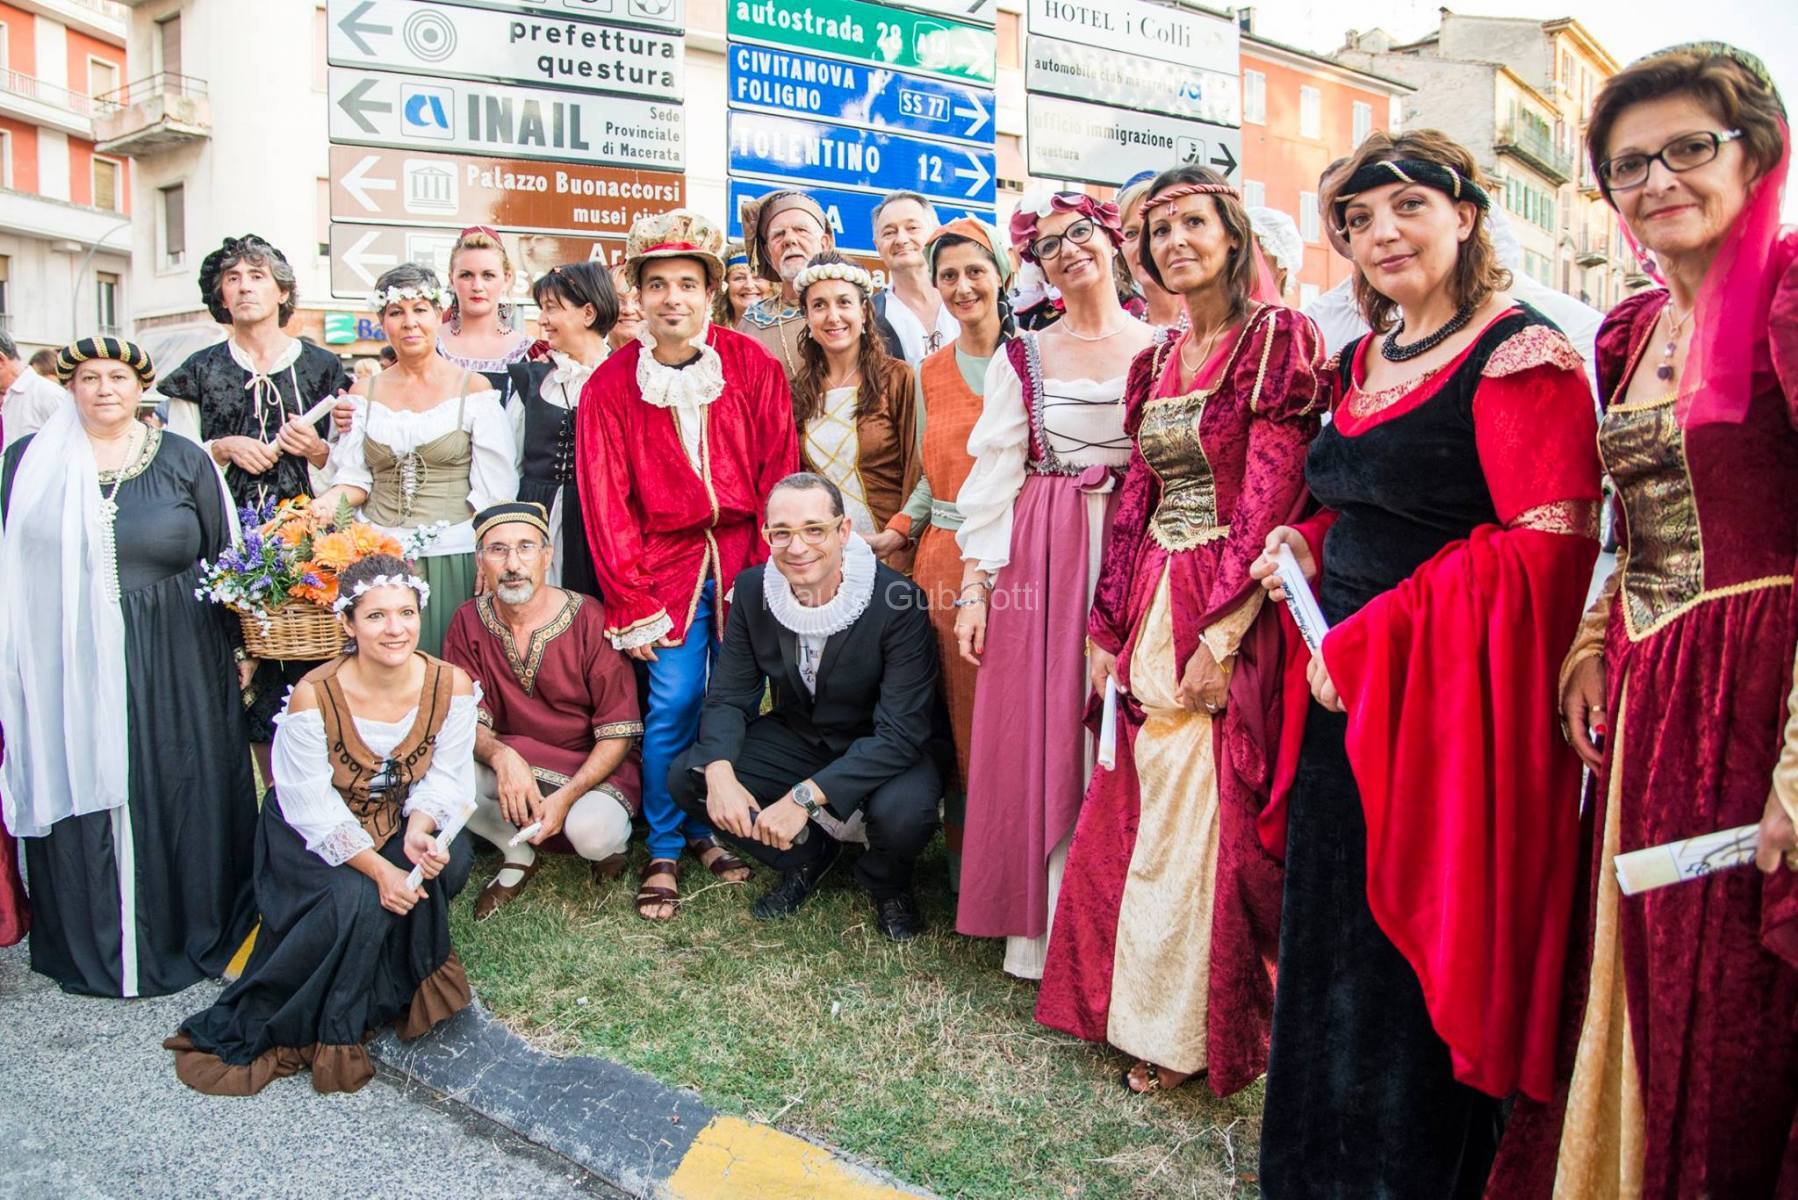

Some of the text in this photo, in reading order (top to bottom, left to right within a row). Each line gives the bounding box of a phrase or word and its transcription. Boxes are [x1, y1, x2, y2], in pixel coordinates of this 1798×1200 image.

[509, 20, 676, 59] prefettura
[736, 1, 864, 44] autostrada
[1044, 0, 1191, 47] HOTEL i Colli
[537, 54, 676, 88] questura
[736, 49, 855, 90] CIVITANOVA
[737, 77, 821, 111] FOLIGNO
[902, 92, 945, 118] SS 77
[467, 94, 589, 151] INAIL
[649, 106, 680, 122] Sede
[605, 121, 680, 142] Provinciale
[1086, 121, 1173, 149] immigrazione
[602, 141, 680, 161] di Macerata
[737, 128, 943, 183] TOLENTINO 12
[466, 165, 681, 201] Palazzo Buonaccorsi
[573, 206, 626, 225] musei
